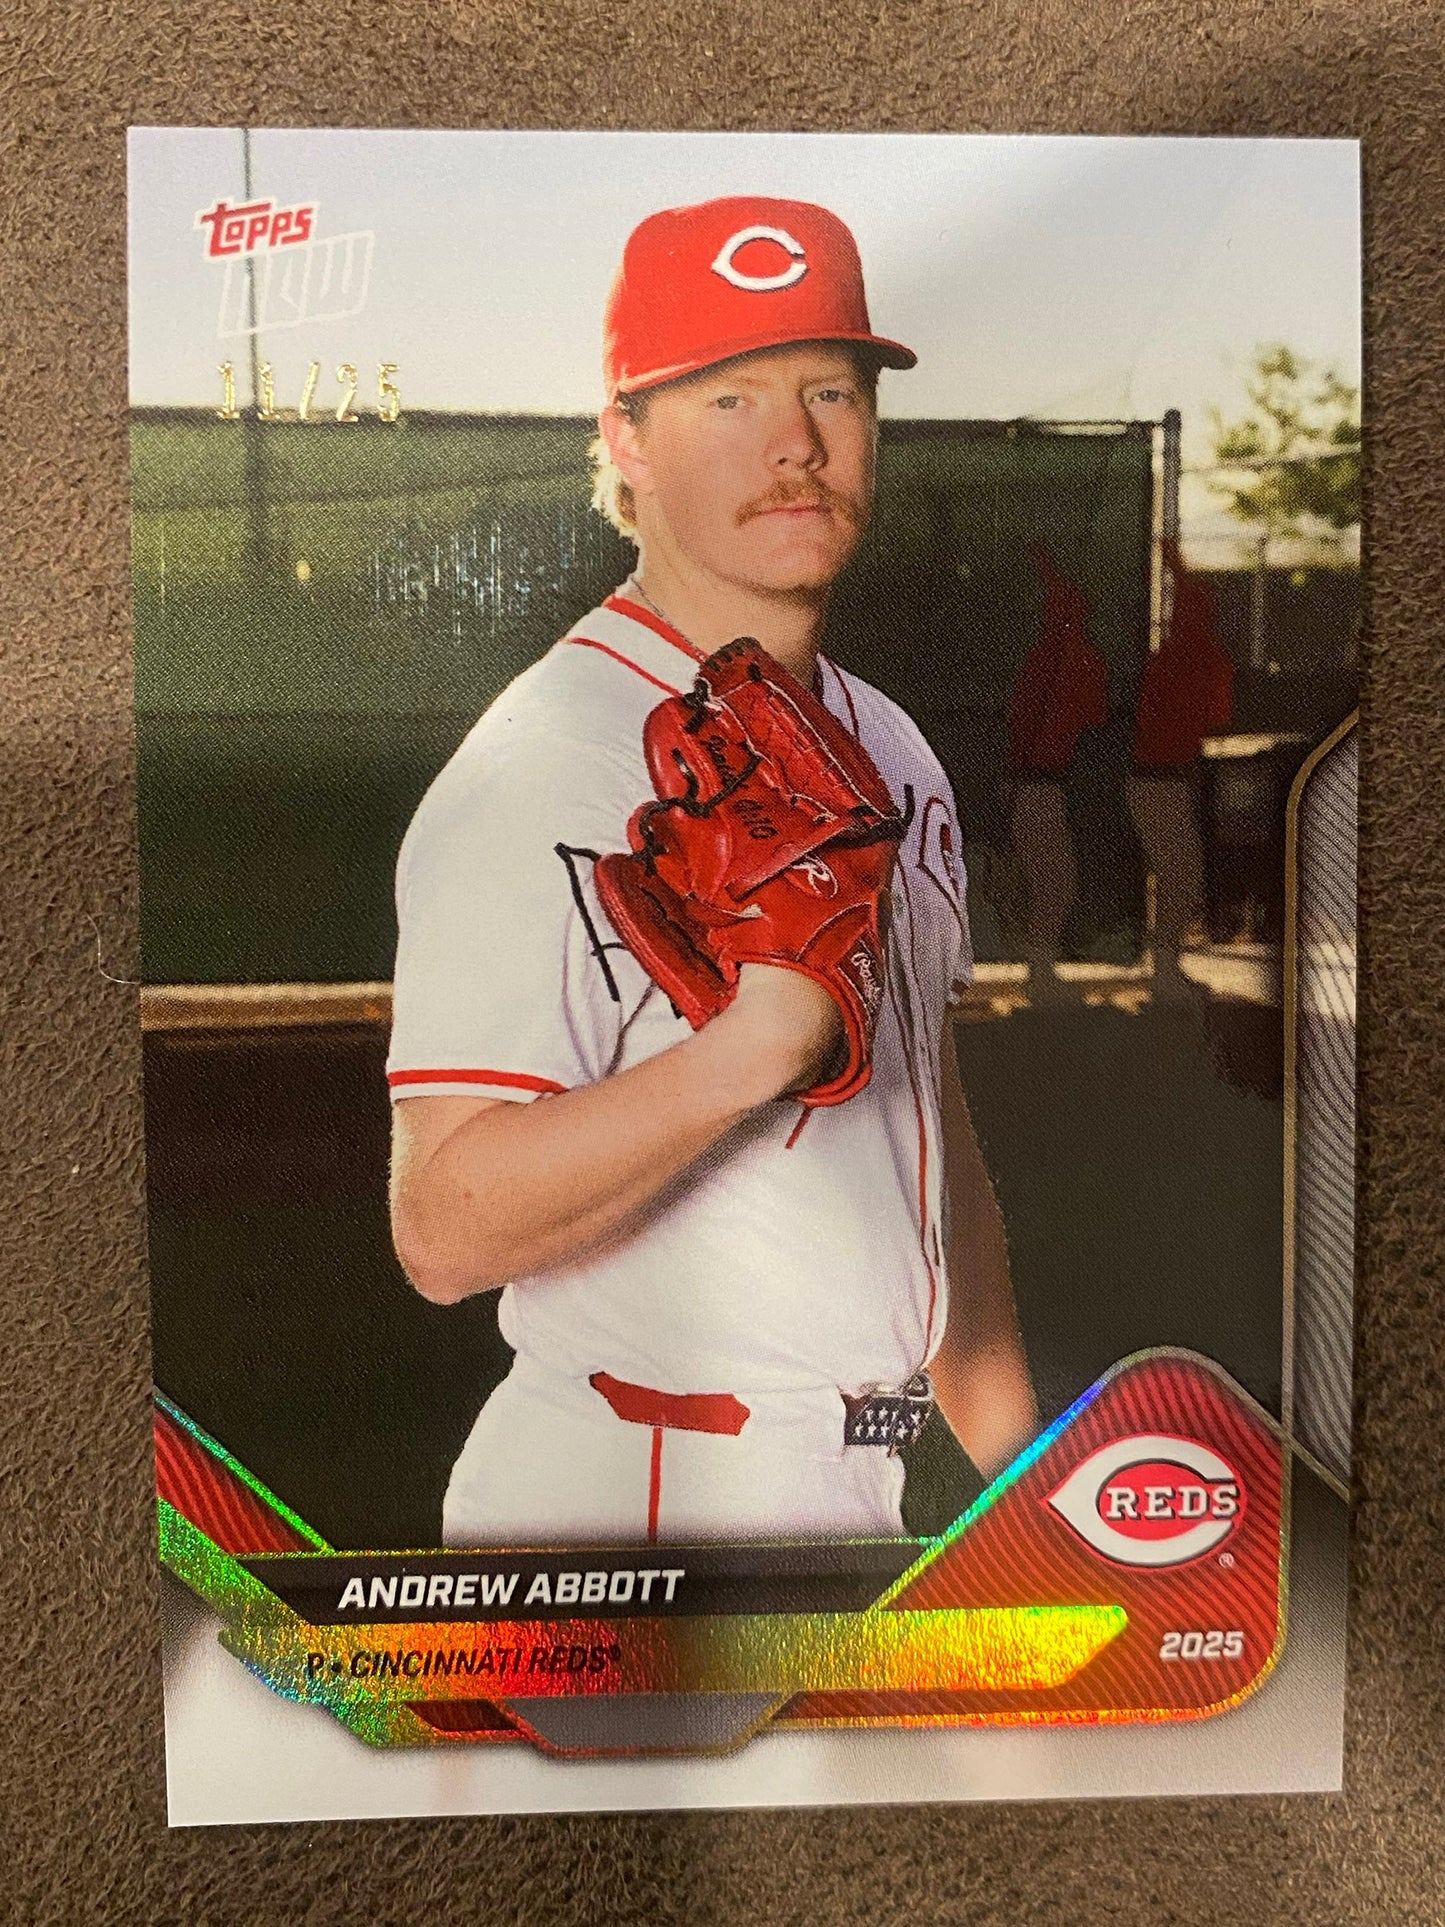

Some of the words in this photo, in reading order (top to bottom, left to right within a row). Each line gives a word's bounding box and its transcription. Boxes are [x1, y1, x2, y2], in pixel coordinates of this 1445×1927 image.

[200, 202, 313, 257] topps
[216, 360, 400, 423] 11/25
[1105, 1485, 1238, 1520] REDS
[338, 1574, 519, 1609] ANDREW
[523, 1569, 686, 1604] ABBOTT
[304, 1652, 325, 1679] P
[349, 1647, 522, 1678] CINCINNATI
[1159, 1630, 1244, 1661] 2025
